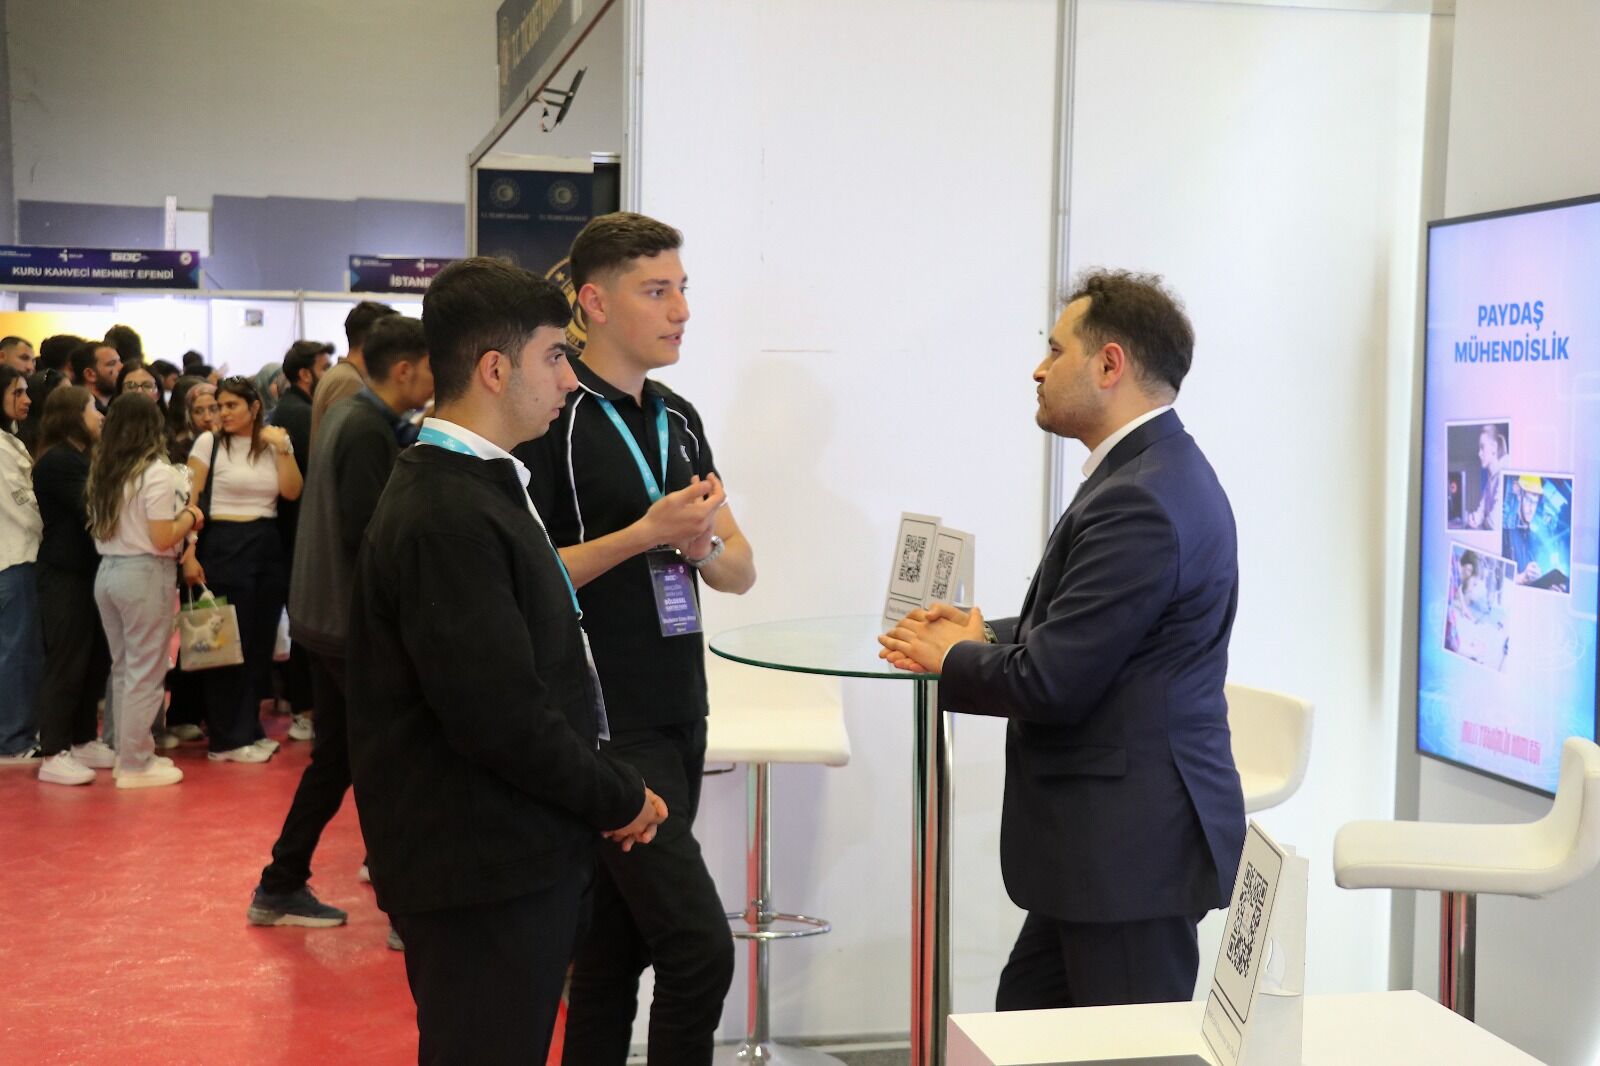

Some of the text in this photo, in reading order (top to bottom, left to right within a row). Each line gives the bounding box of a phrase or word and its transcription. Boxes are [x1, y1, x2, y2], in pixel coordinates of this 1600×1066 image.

[12, 266, 174, 280] KURU KAHVECİ MEHMET EFENDİ
[1478, 300, 1544, 331] PAYDAŞ
[1454, 331, 1570, 363] MÜHENDİSLİK
